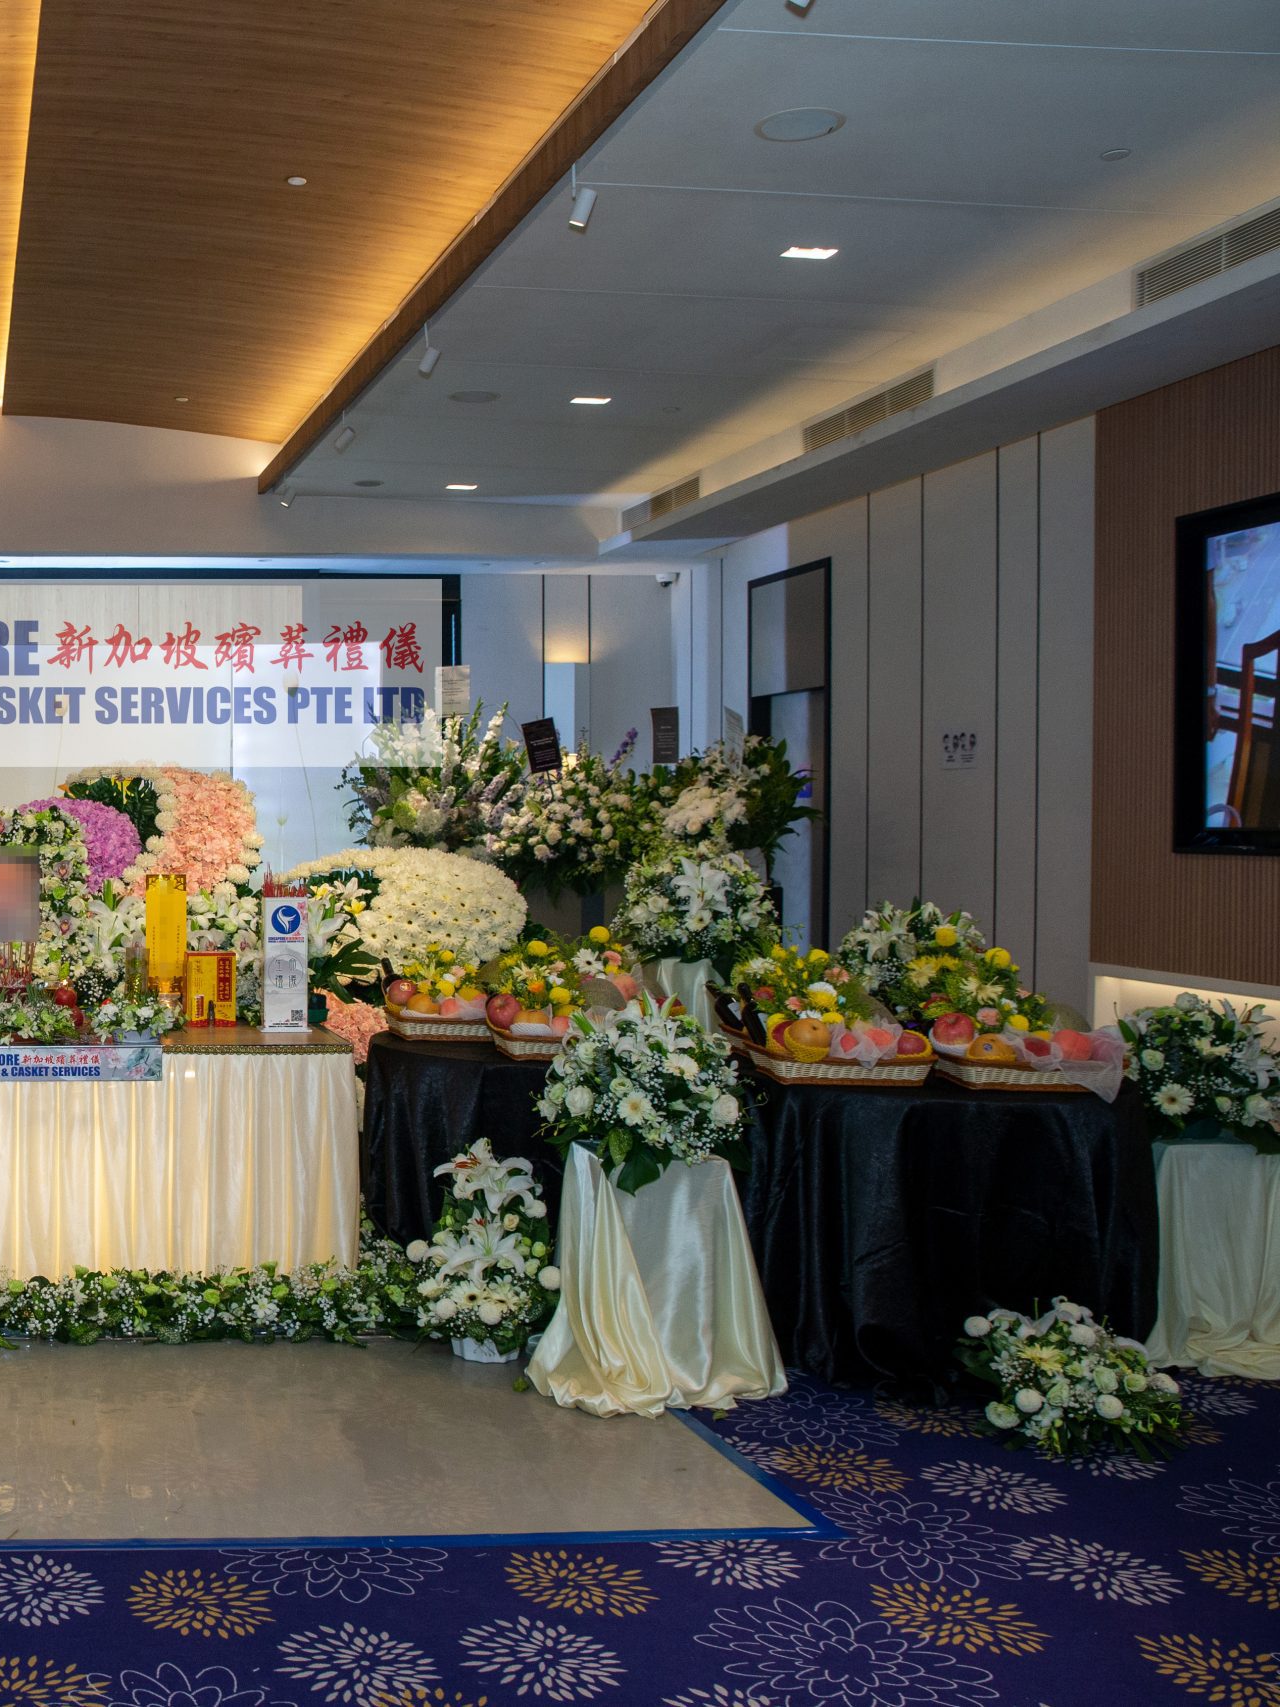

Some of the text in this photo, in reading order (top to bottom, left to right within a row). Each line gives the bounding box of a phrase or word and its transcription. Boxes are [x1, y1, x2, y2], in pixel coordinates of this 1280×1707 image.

[1, 1067, 9, 1077] &
[11, 1066, 50, 1077] CASKET
[52, 1066, 101, 1077] SERVICES
